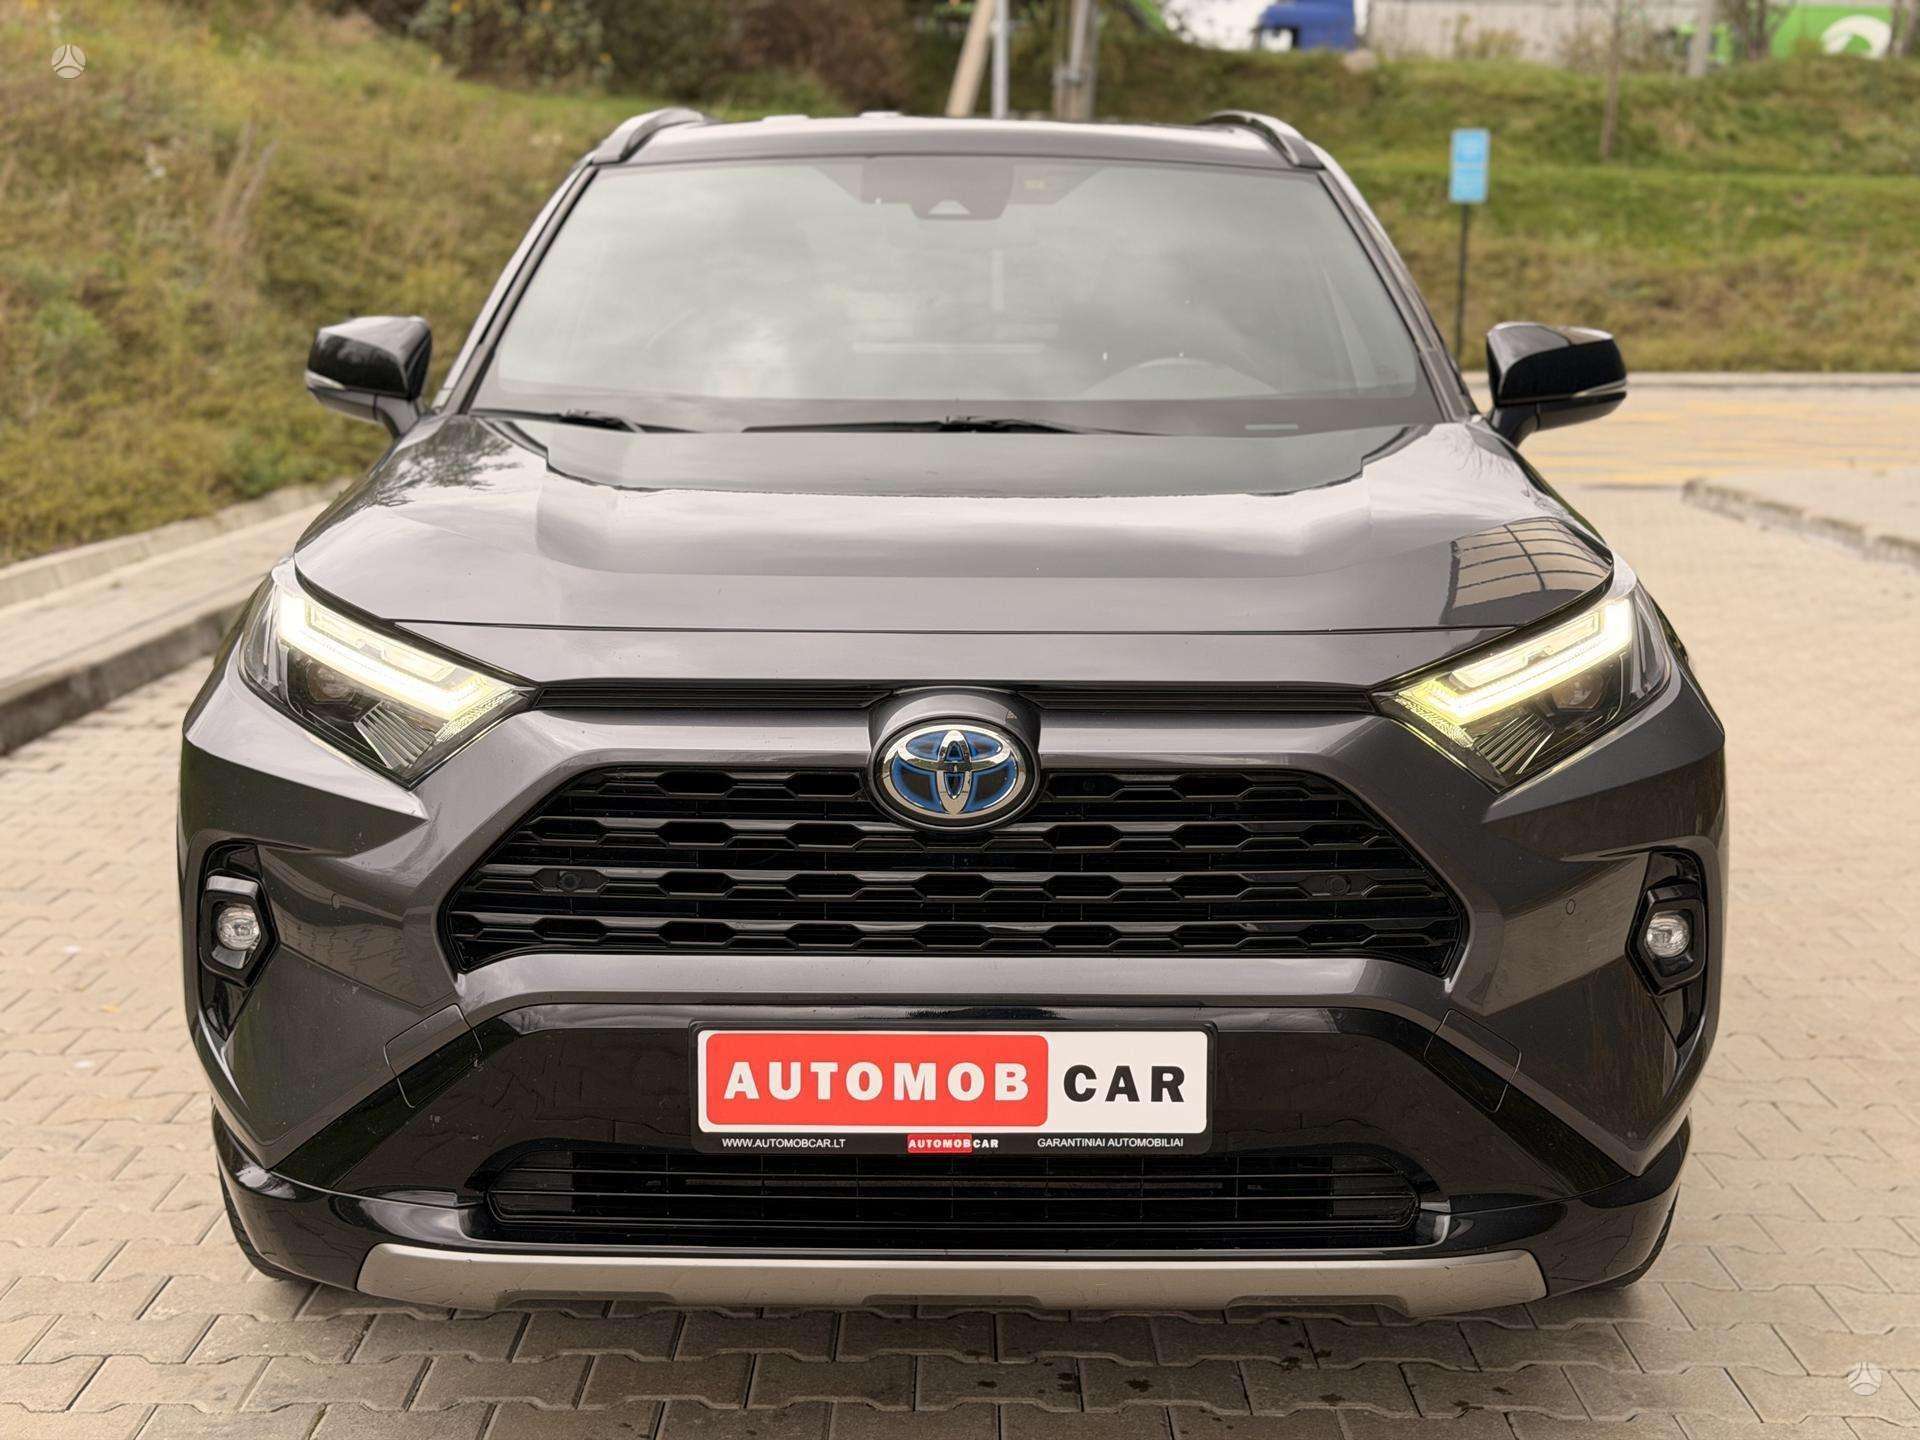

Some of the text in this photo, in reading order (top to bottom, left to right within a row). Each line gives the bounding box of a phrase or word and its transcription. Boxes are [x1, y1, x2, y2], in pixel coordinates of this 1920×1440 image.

[723, 1061, 1186, 1103] AUTOMOB CAR
[722, 1138, 846, 1148] WWW.AUTOMOBCAR.LT
[1037, 1138, 1184, 1147] GARANTINIAI AUTOMOBILIAI
